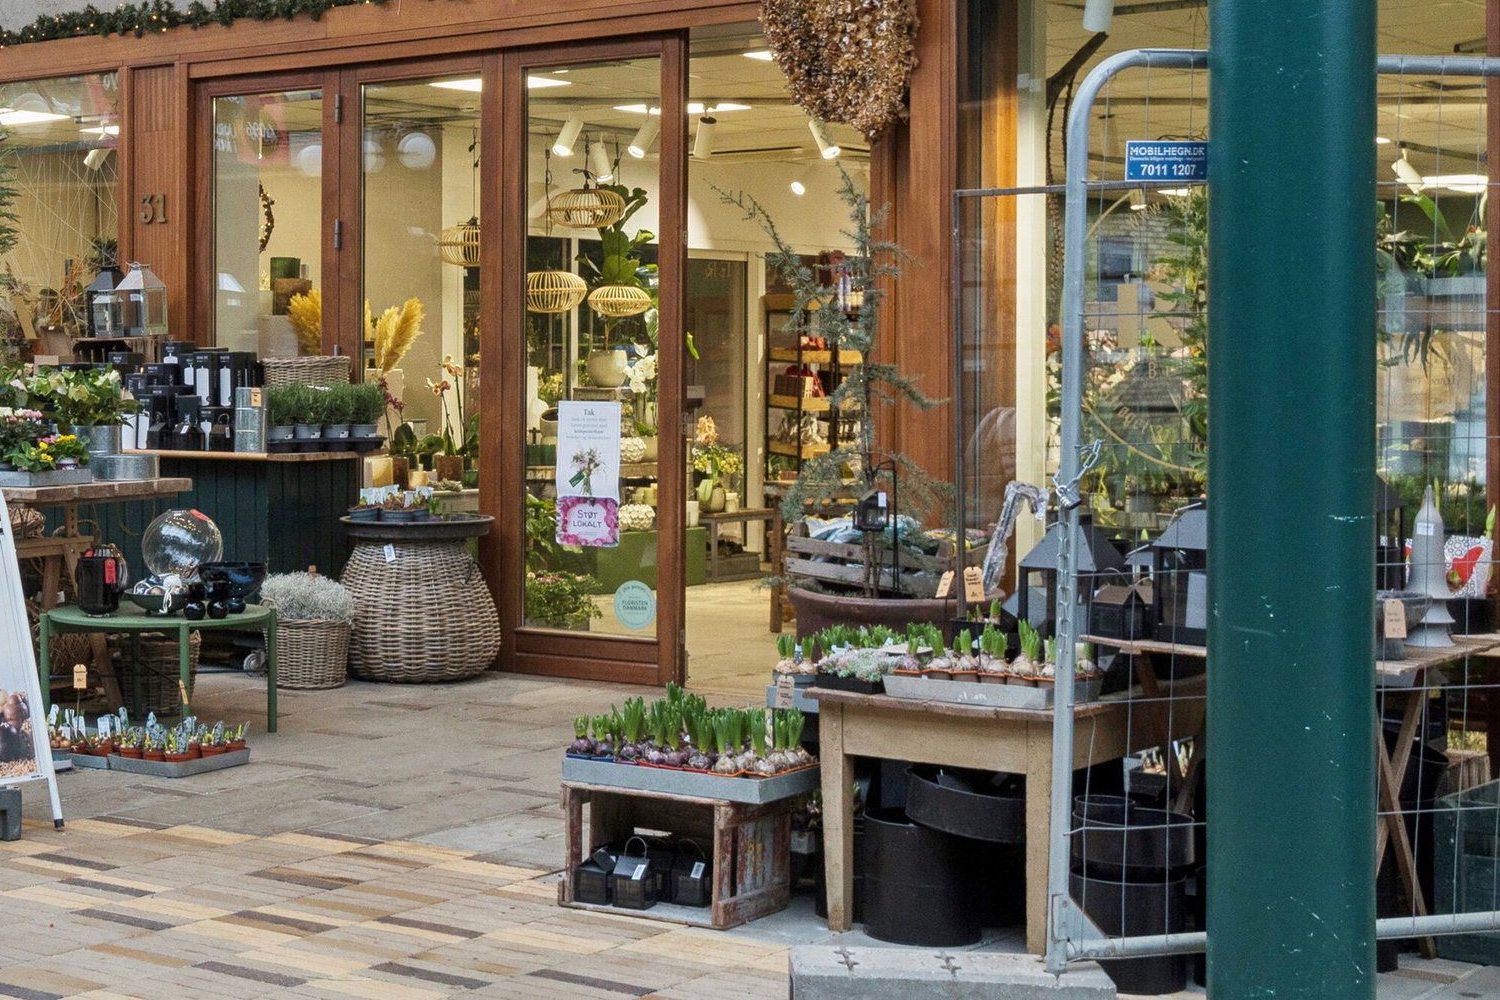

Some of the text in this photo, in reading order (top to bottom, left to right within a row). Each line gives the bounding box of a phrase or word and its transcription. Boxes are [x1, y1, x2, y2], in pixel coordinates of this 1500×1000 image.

[1129, 146, 1205, 156] MOBILHEGN.DK
[1140, 164, 1196, 176] 7011 1207
[140, 192, 166, 224] 31
[583, 408, 595, 416] Tak
